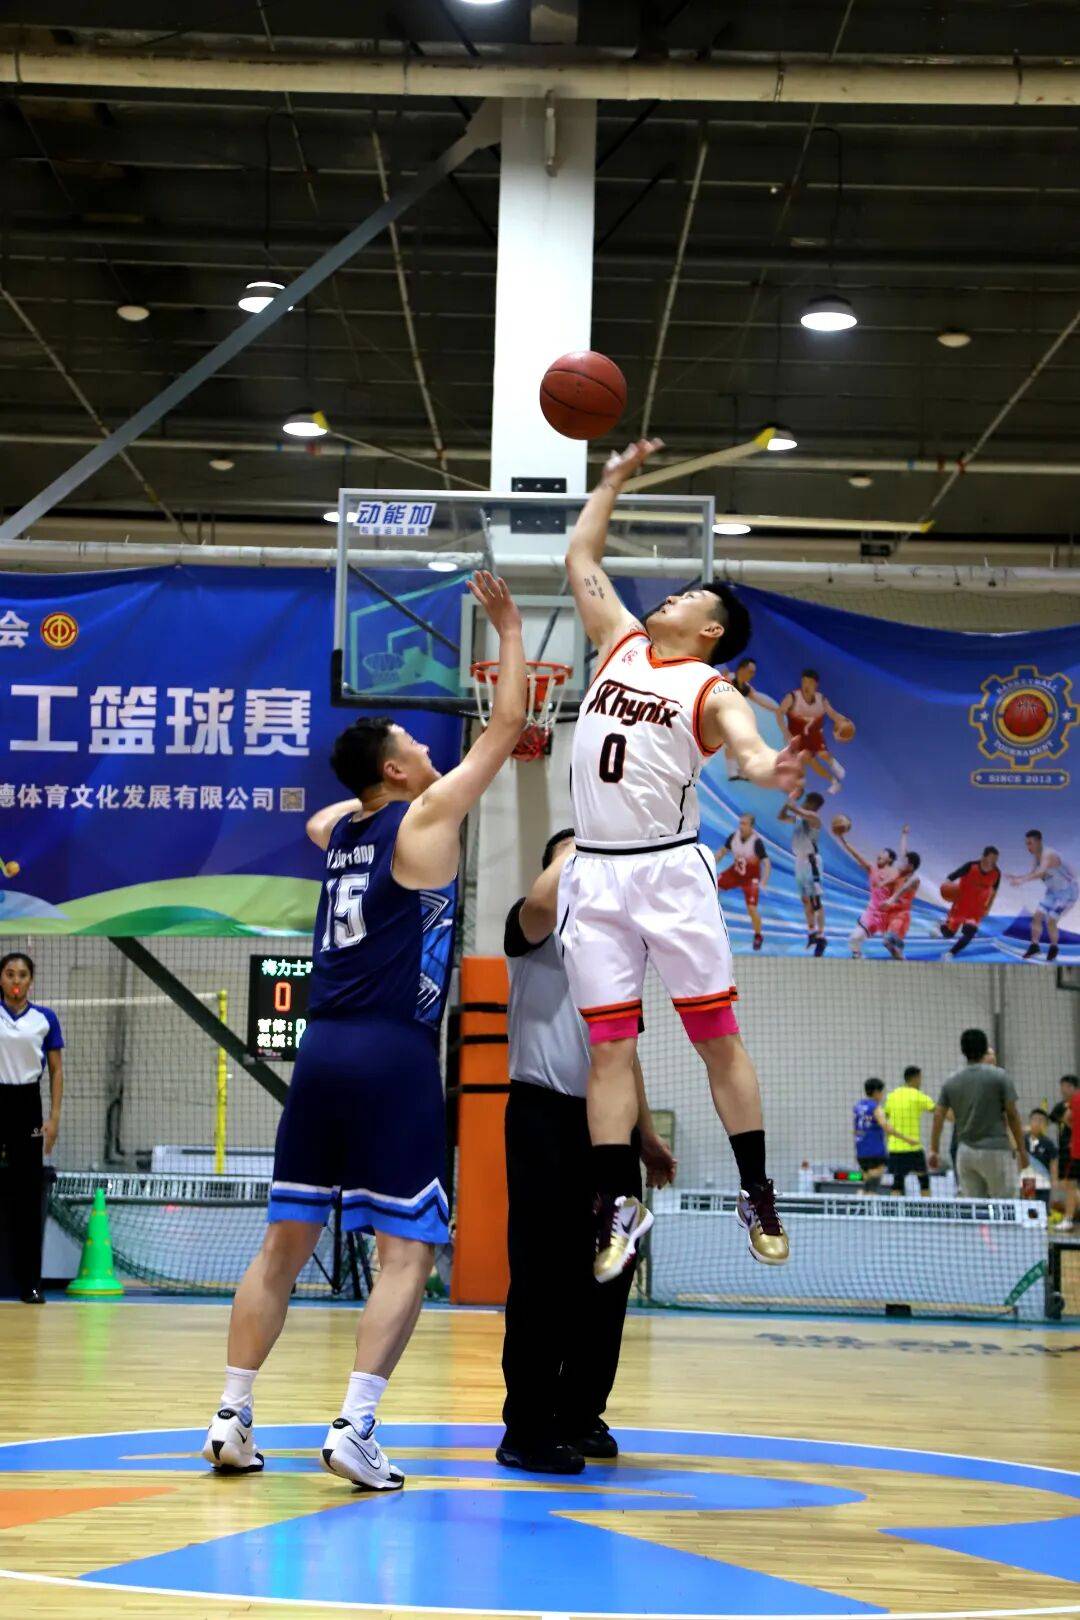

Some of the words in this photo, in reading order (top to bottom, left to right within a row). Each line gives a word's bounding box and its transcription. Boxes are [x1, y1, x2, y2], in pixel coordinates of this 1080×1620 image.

[357, 504, 433, 525] 动能加
[0, 610, 30, 649] 会
[10, 684, 311, 756] 工篮球赛
[599, 733, 627, 783] 0
[0, 783, 273, 810] 德体育文化发展有限公司
[988, 774, 1021, 784] SINCE
[320, 873, 370, 952] 15
[274, 981, 292, 1012] 0
